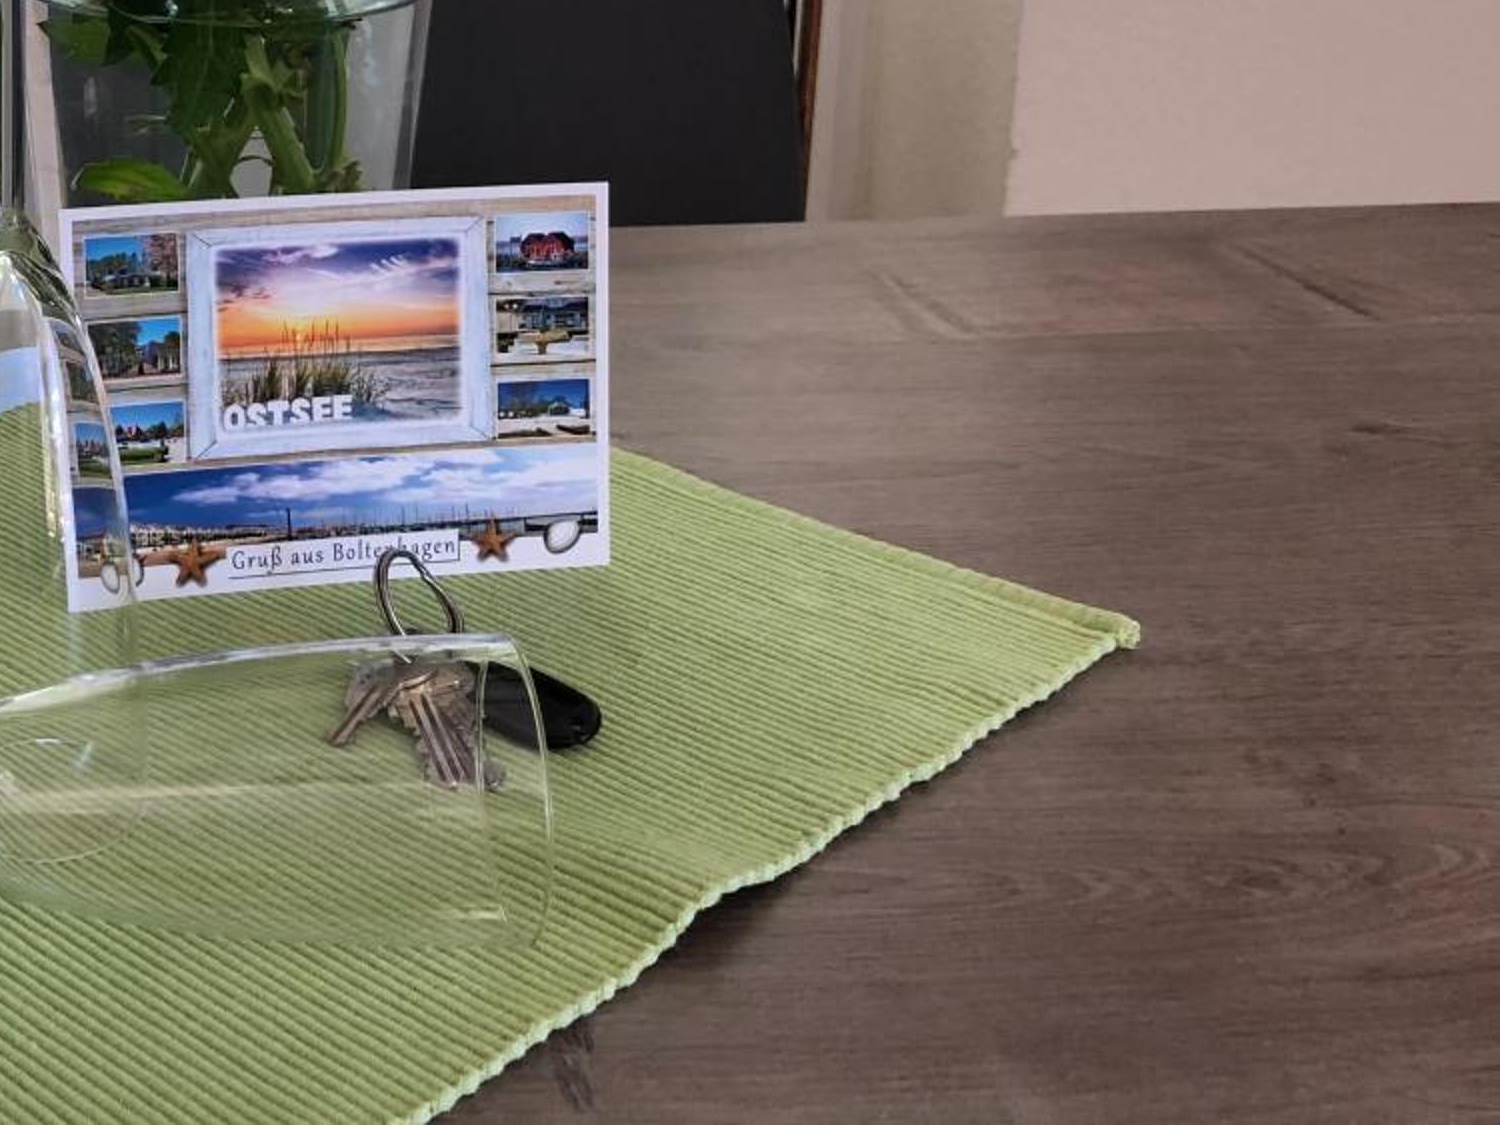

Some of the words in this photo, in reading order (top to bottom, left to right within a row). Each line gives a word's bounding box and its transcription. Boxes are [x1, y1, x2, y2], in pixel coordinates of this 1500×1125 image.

[223, 394, 353, 429] OSTSEE
[231, 545, 283, 571] Gruß
[290, 549, 325, 565] aus
